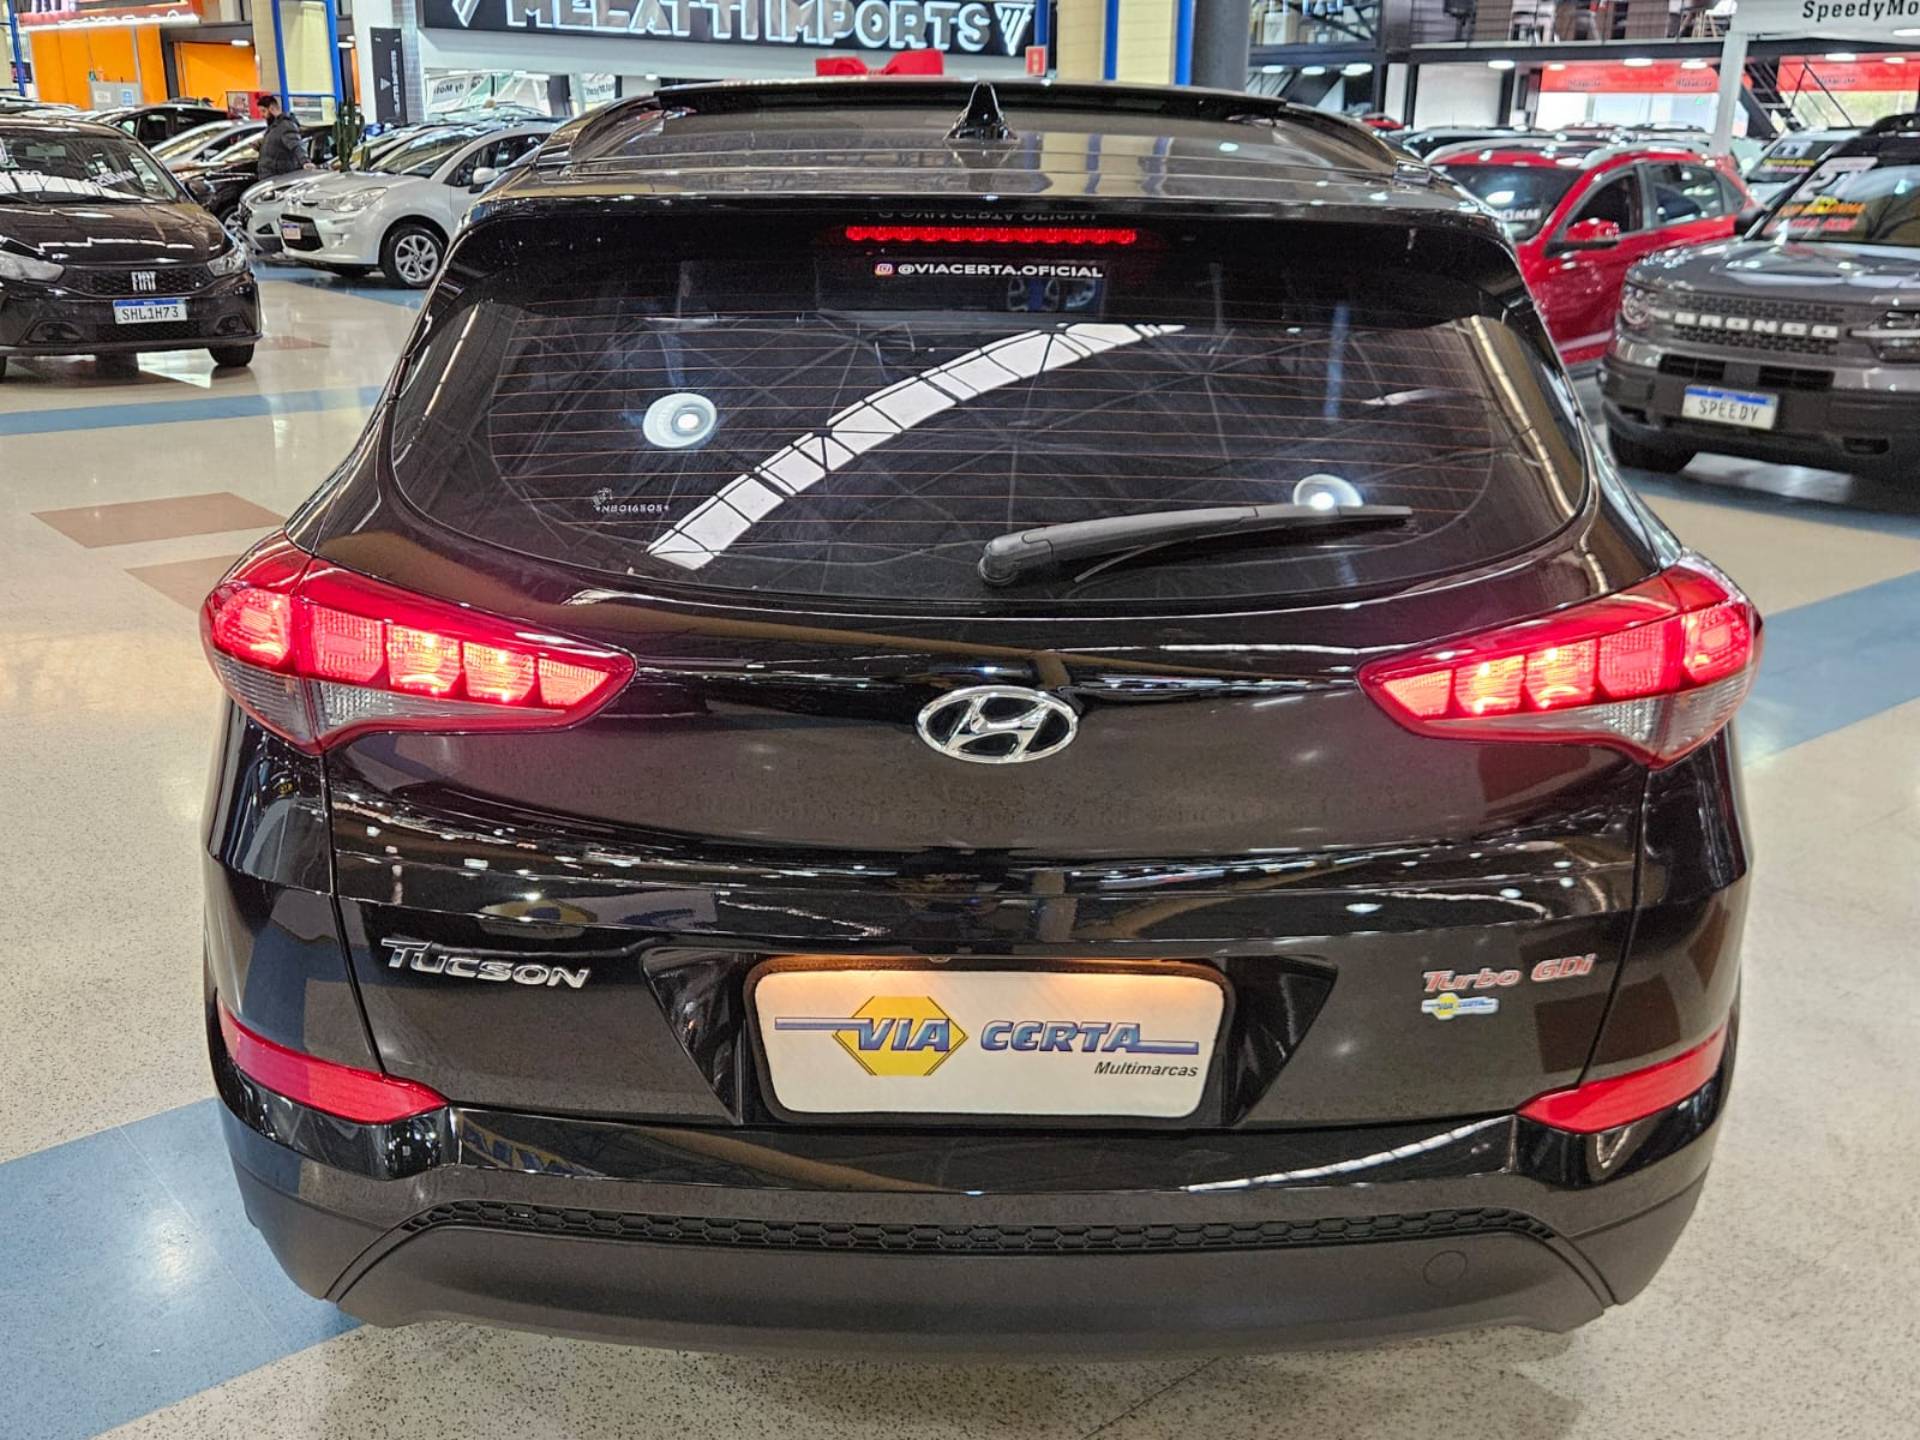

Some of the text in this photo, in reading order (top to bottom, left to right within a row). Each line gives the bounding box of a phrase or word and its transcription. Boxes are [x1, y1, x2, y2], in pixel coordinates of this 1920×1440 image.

[505, 0, 991, 51] MELATTI IMPORTS
[131, 271, 157, 291] FIAT
[898, 262, 1103, 278] @VIACERTA.OFICIAL
[121, 305, 179, 321] SHL1H73
[1674, 312, 1838, 339] BRONCO
[1697, 399, 1760, 422] SPEEDY
[381, 937, 590, 989] TUCSON
[1423, 952, 1597, 993] Turbo GDi
[858, 1017, 1141, 1054] VIA CERTA
[1094, 1060, 1200, 1079] Multimarcas
